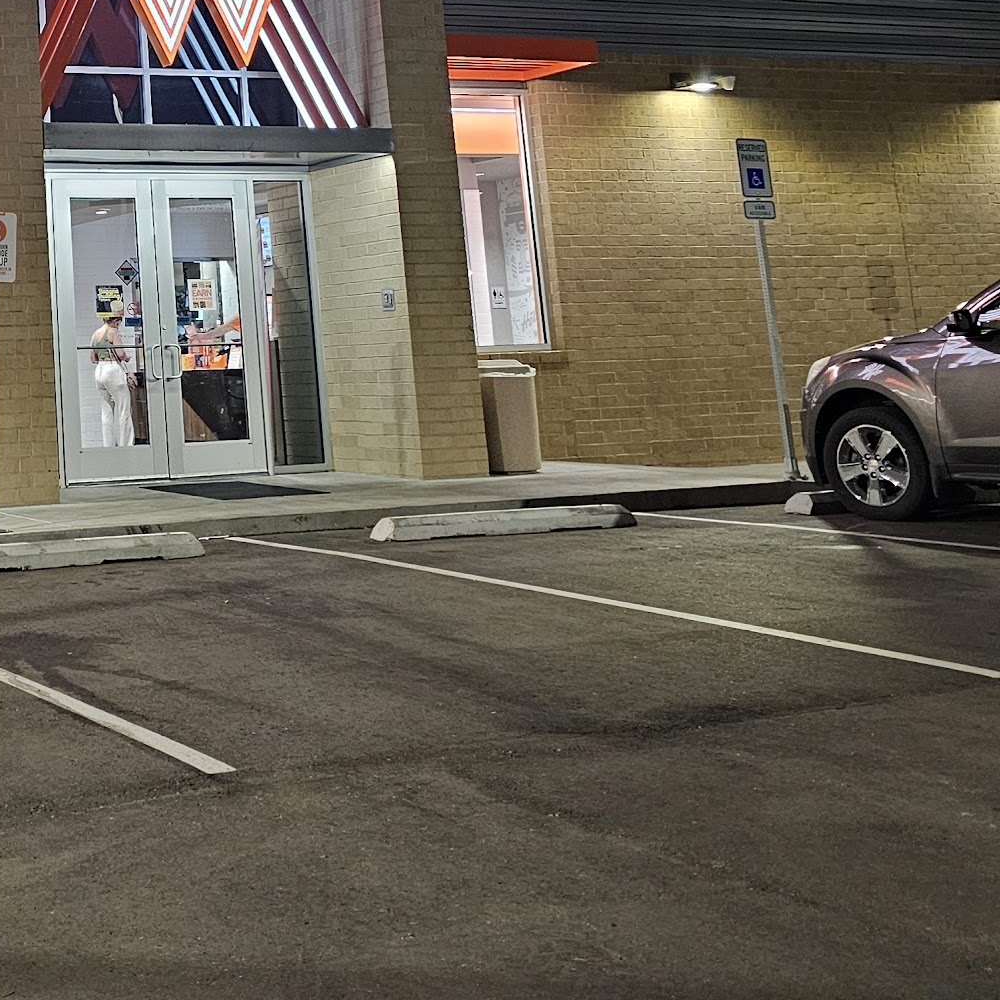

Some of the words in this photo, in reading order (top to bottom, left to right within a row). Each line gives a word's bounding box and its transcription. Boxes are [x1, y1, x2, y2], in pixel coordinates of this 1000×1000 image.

[738, 144, 766, 152] RESERVED
[741, 154, 765, 162] PARKING
[191, 289, 213, 297] EARN
